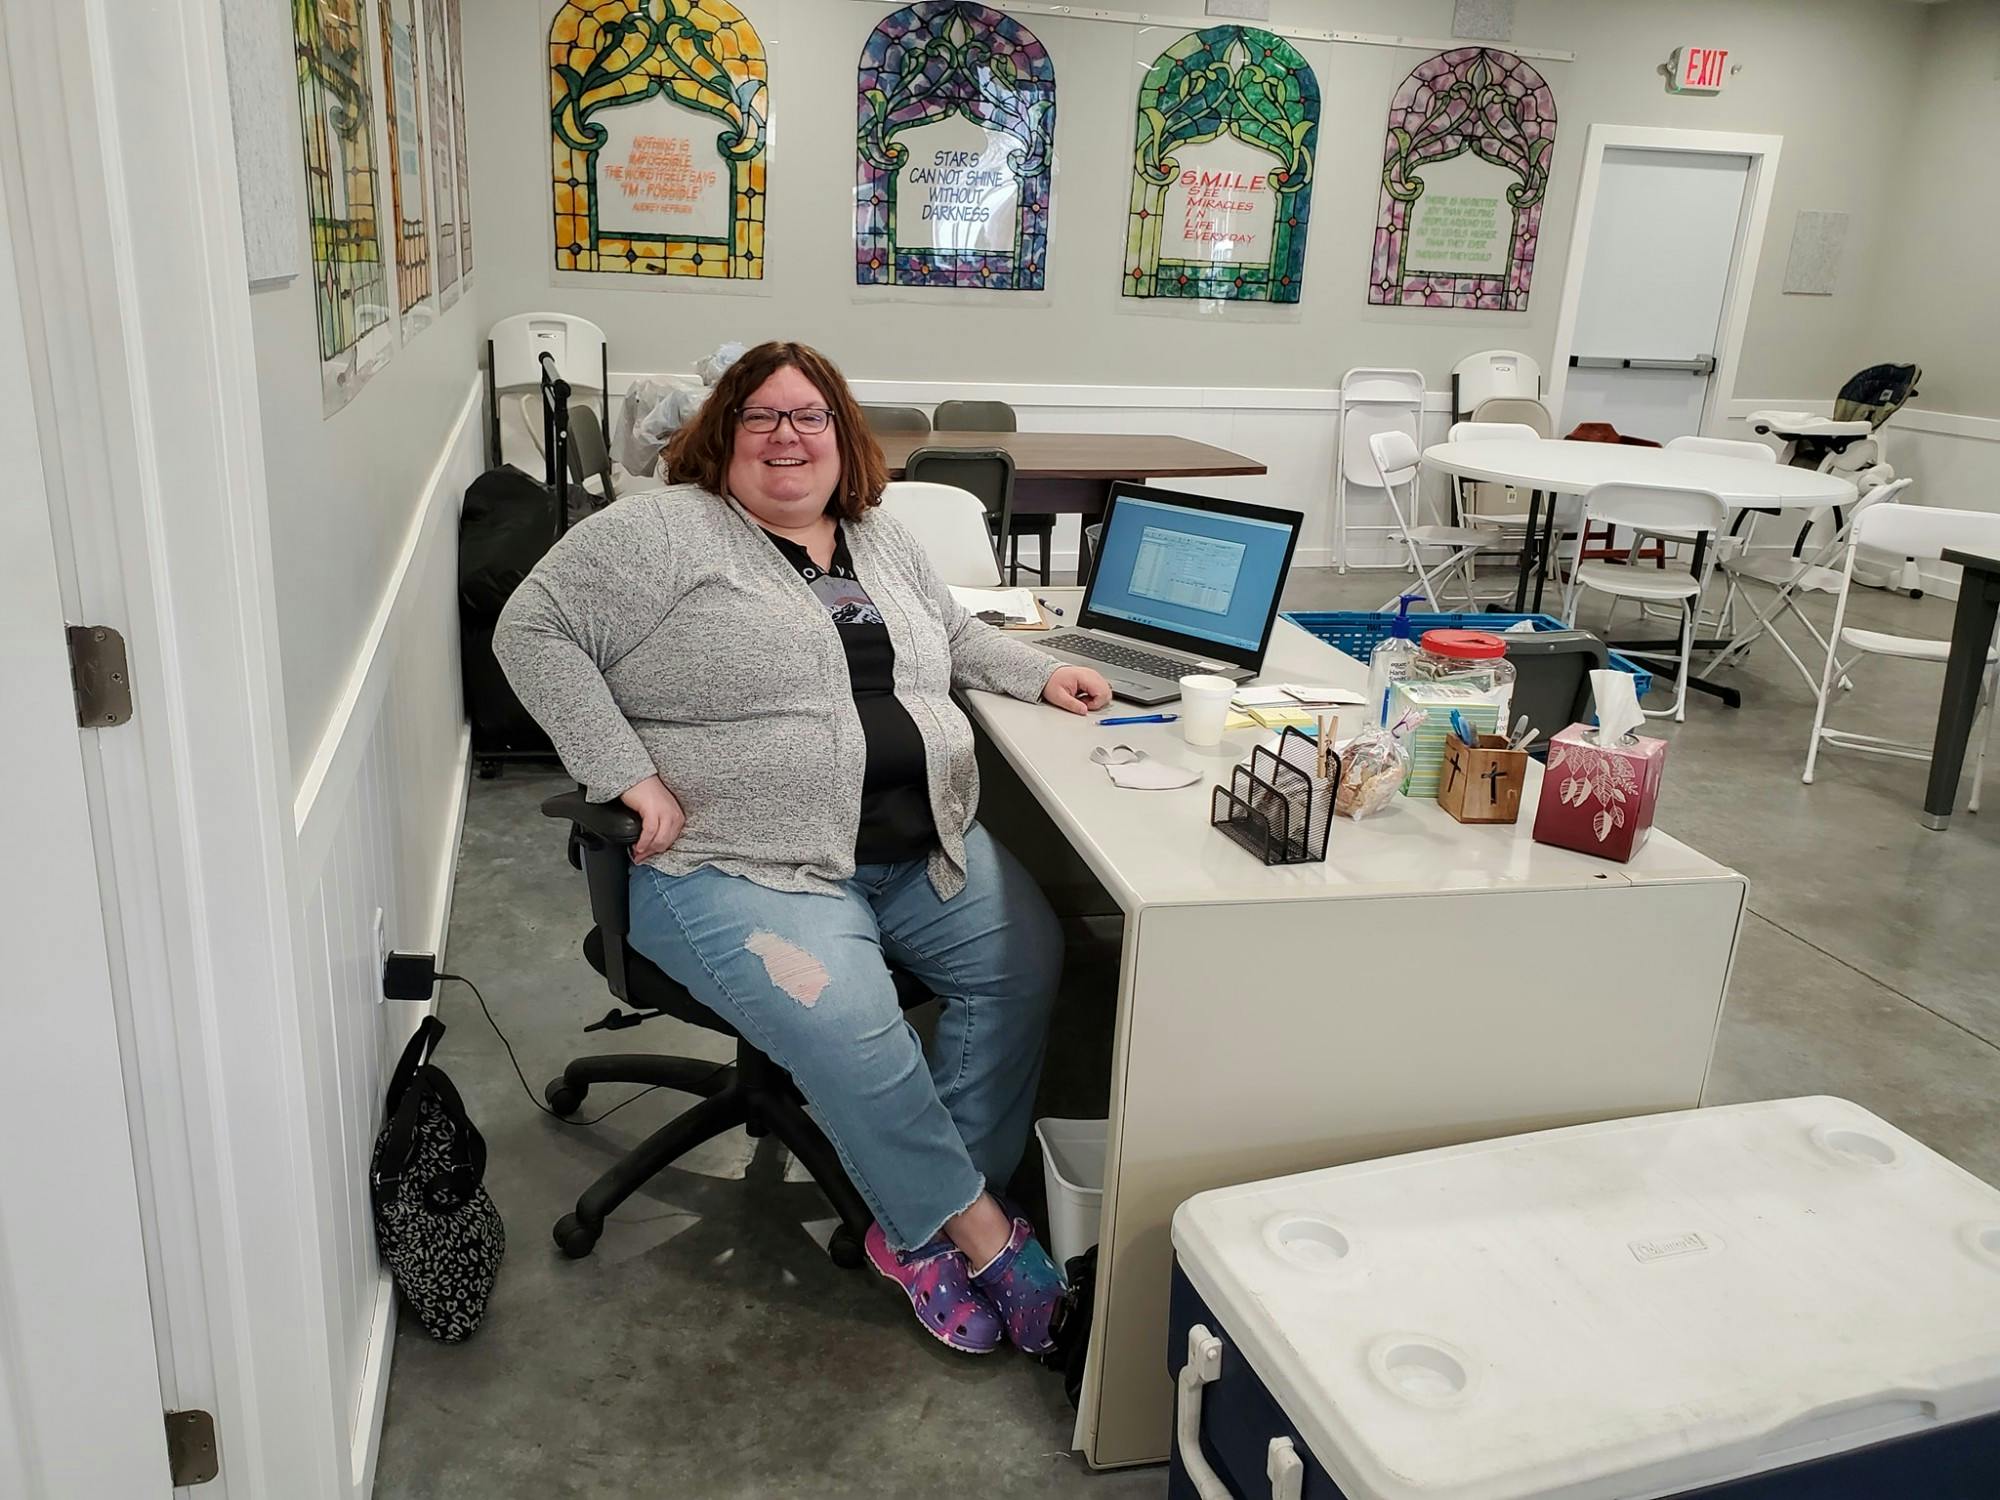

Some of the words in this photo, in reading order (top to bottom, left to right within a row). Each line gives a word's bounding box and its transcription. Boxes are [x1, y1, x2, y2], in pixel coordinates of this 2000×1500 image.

[1685, 48, 1729, 87] EXIT
[633, 136, 676, 151] NOTHING
[679, 138, 690, 152] IS
[934, 150, 980, 168] STARS
[604, 165, 624, 181] THE
[624, 166, 655, 181] WORD
[655, 167, 689, 183] ITSELF
[689, 170, 717, 187] SAYS
[965, 170, 1003, 187] SHINE
[929, 186, 984, 204] WITHOUT
[1188, 186, 1220, 198] SEE
[1187, 197, 1254, 211] MIRACLES
[921, 204, 990, 222] DARKNESS
[1186, 208, 1206, 218] IN
[1185, 219, 1214, 230] LIFE
